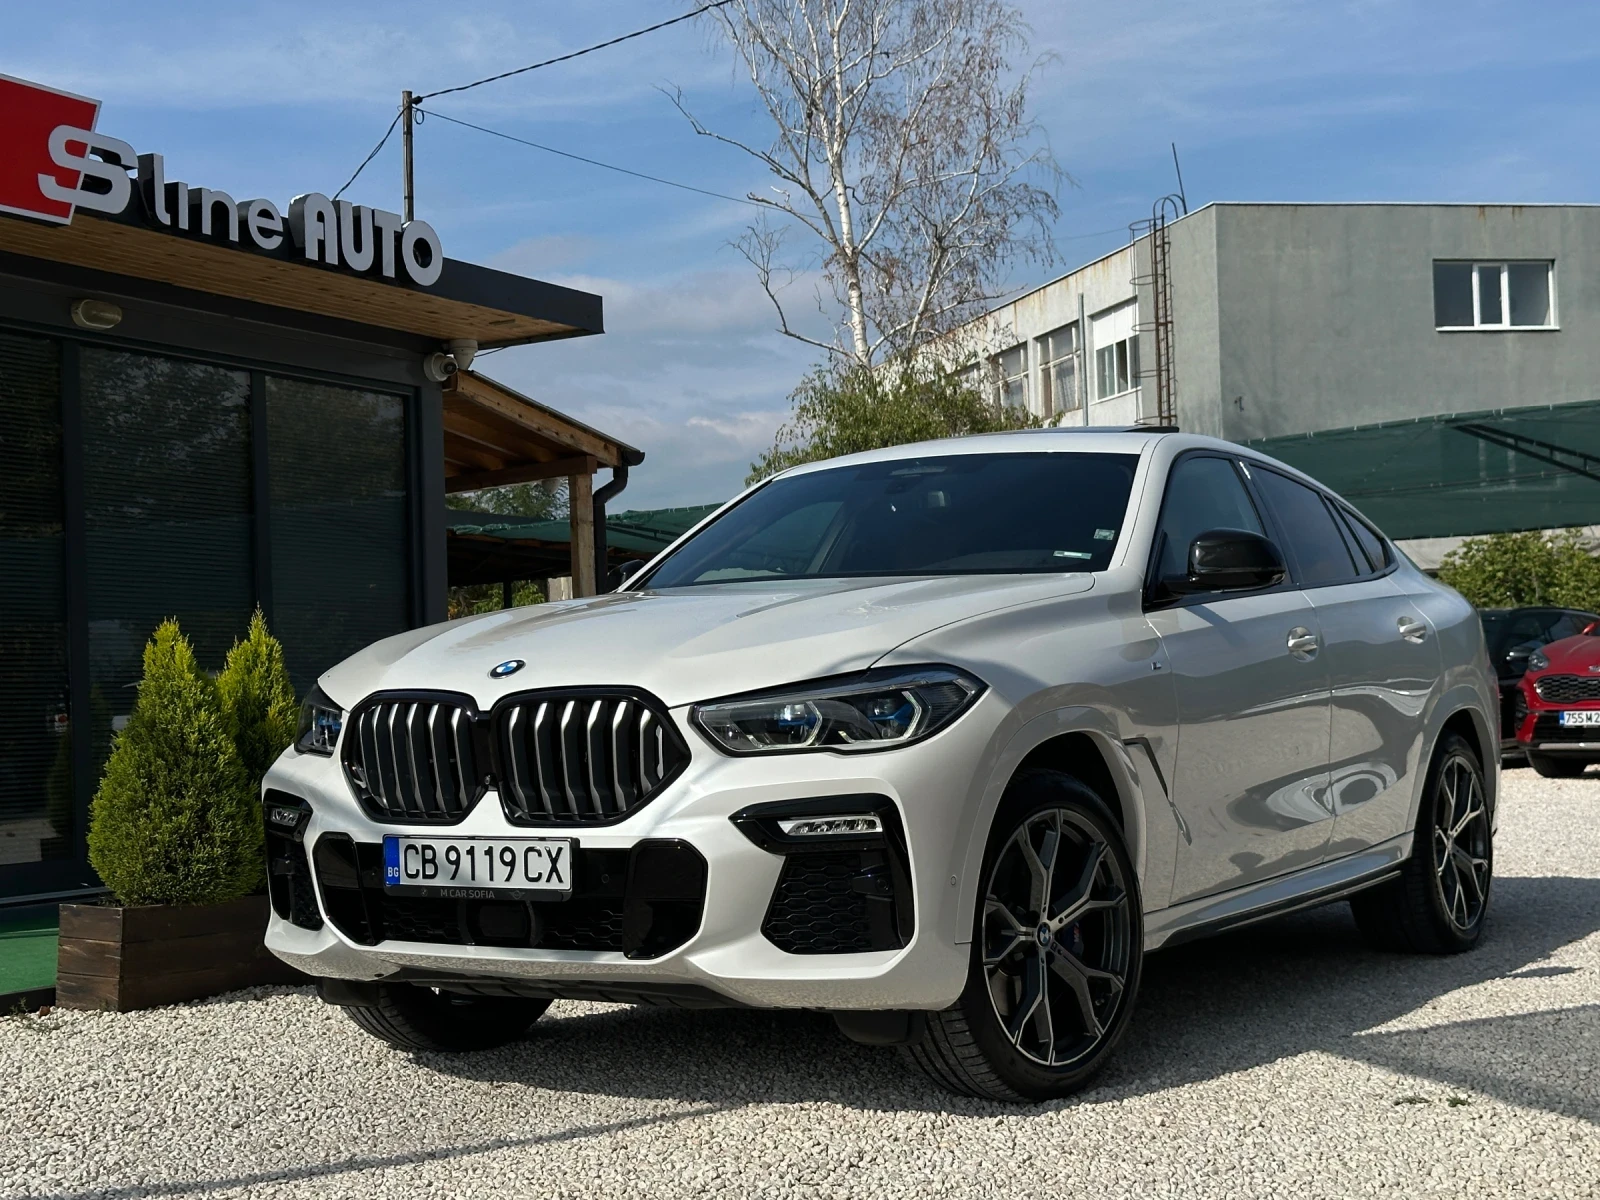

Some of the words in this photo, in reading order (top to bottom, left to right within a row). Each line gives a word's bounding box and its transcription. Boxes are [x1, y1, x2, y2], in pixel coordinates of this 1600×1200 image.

[37, 124, 139, 215] S
[303, 192, 444, 287] AUTO
[387, 866, 399, 878] BG
[403, 843, 439, 880] CB
[444, 844, 517, 882] 9119
[523, 845, 564, 883] CX
[449, 889, 467, 898] CAR
[469, 889, 495, 899] SOFIA
